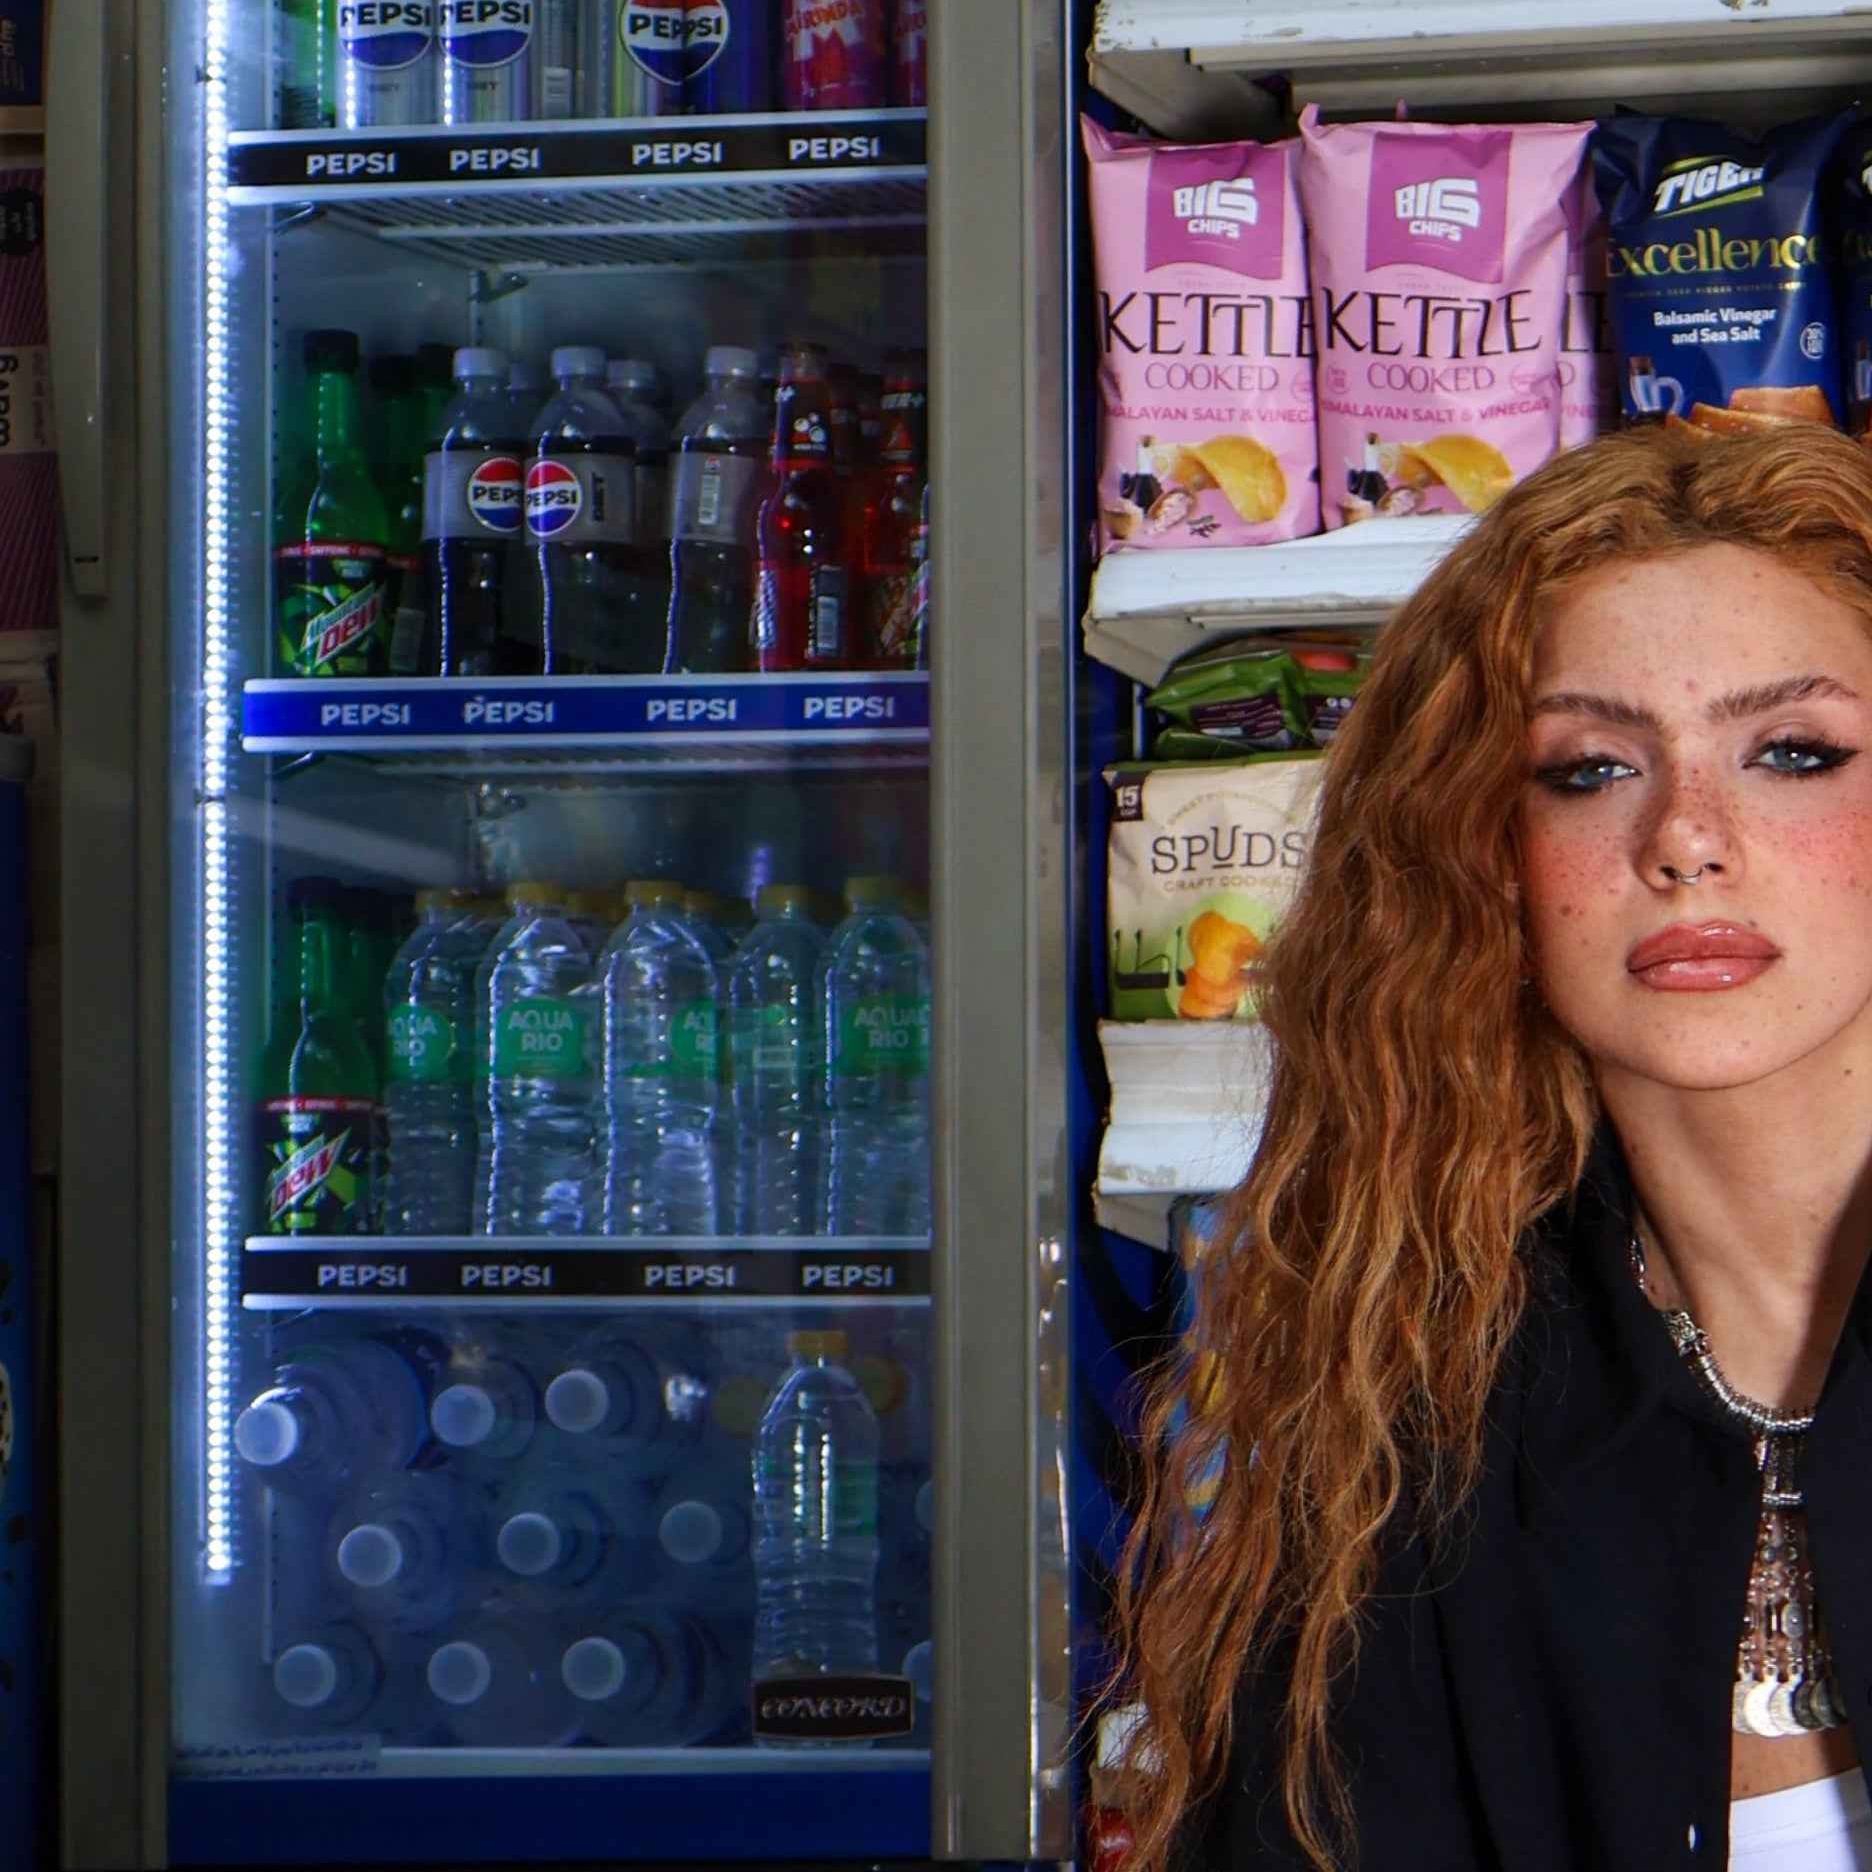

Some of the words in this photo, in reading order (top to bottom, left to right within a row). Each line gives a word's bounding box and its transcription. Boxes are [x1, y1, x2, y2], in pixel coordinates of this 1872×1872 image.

[341, 2, 432, 27] PEPSI
[439, 0, 530, 25] PEPSI
[306, 152, 397, 176] PEPSI
[449, 147, 540, 172] PEPSI
[632, 141, 723, 167] PEPSI
[788, 135, 880, 161] PEPSI
[1172, 178, 1259, 226] BIG
[1395, 178, 1481, 228] BIG
[1187, 218, 1240, 239] CHIPS
[1409, 219, 1462, 242] CHIPS
[1100, 290, 1318, 358] KETTLE
[1321, 287, 1542, 359] KETTLE
[1654, 308, 1716, 327] Balsamic
[1719, 308, 1776, 327] Vinegar
[1671, 329, 1699, 345] and
[1701, 328, 1726, 344] Sea
[1727, 326, 1760, 343] Salt
[1144, 361, 1280, 392] COOKED
[1366, 361, 1496, 392] COOKED
[1194, 406, 1237, 423] SALT
[1412, 404, 1457, 423] SALT
[1480, 397, 1552, 421] VINEGAR
[321, 702, 410, 726] PEPSI
[464, 699, 554, 724] PEPSI
[646, 697, 737, 722] PEPSI
[803, 695, 894, 720] PEPSI
[1116, 786, 1138, 807] 15
[1151, 825, 1304, 875] SPUDS
[507, 1009, 573, 1033] AQUA
[521, 1030, 564, 1052] RIO
[867, 1027, 909, 1049] RIO
[317, 1265, 407, 1287] PEPSI
[461, 1265, 551, 1287] PEPSI
[645, 1264, 735, 1287] PEPSI
[802, 1264, 893, 1287] PEPSI
[757, 1693, 907, 1723] CONCORD
